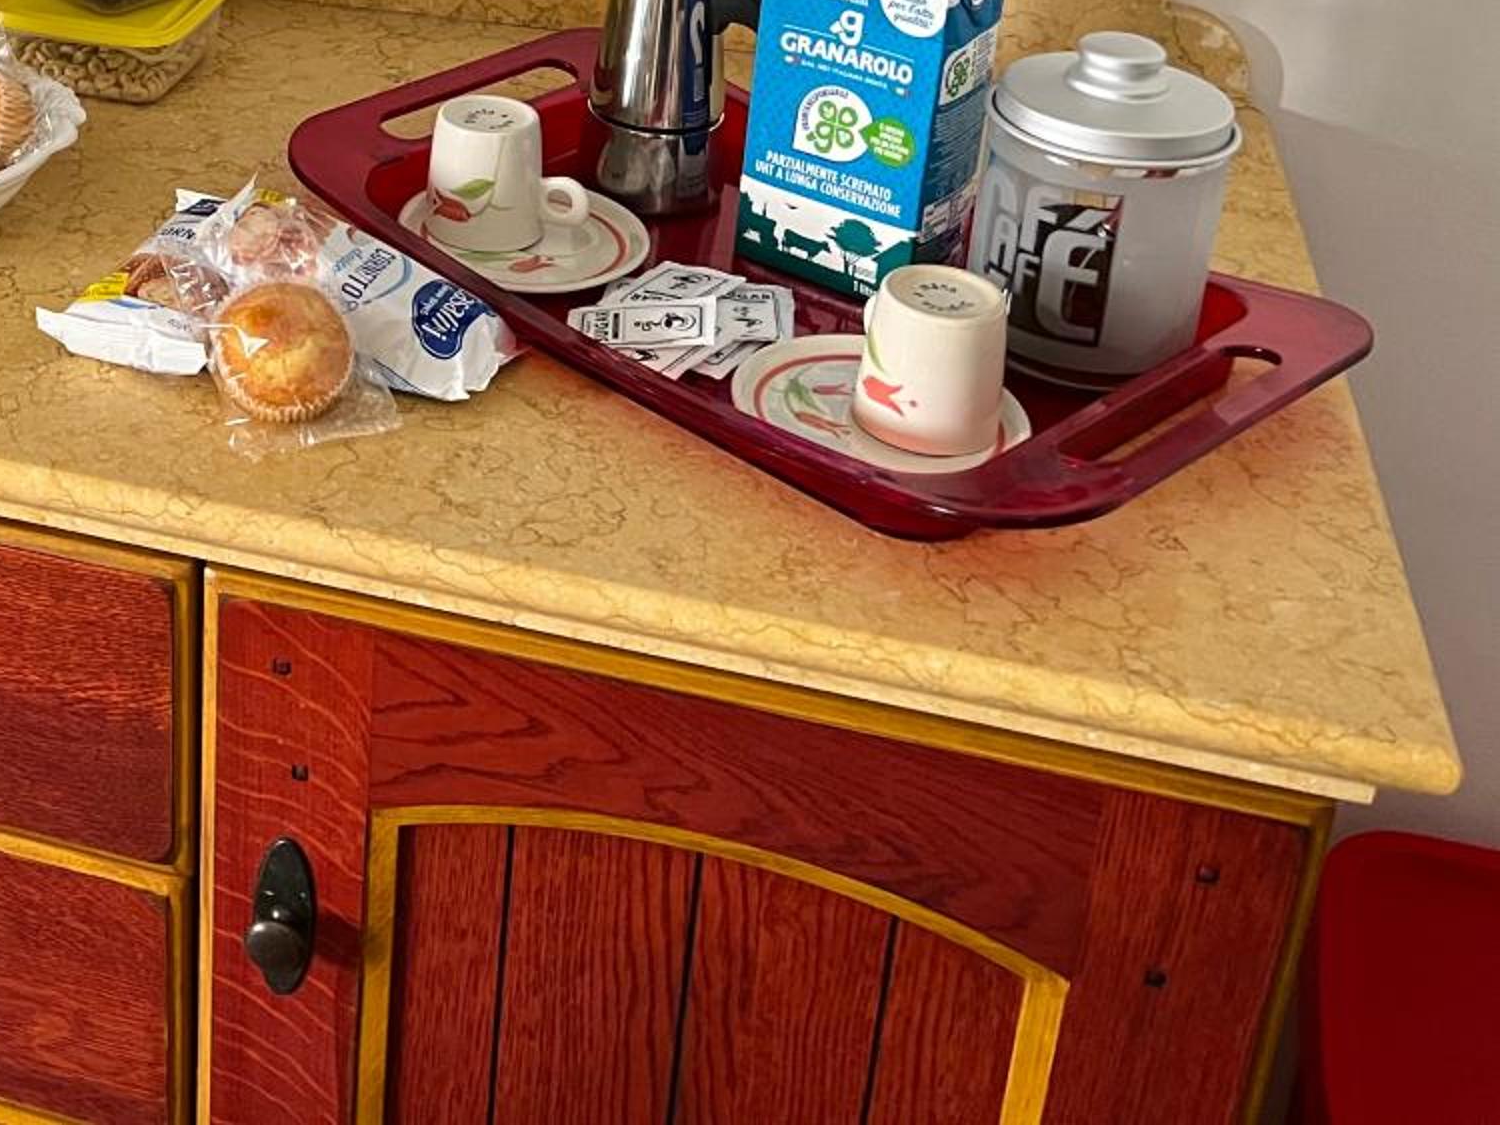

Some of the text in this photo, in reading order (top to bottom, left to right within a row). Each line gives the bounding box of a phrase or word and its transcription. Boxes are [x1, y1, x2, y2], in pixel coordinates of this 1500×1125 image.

[780, 30, 913, 85] GRANAROLO
[765, 150, 892, 201] PARZIALMENTE SCREMATO
[775, 166, 783, 180] A
[785, 168, 817, 191] LUNGA
[819, 181, 901, 219] CONSERVAZIONE
